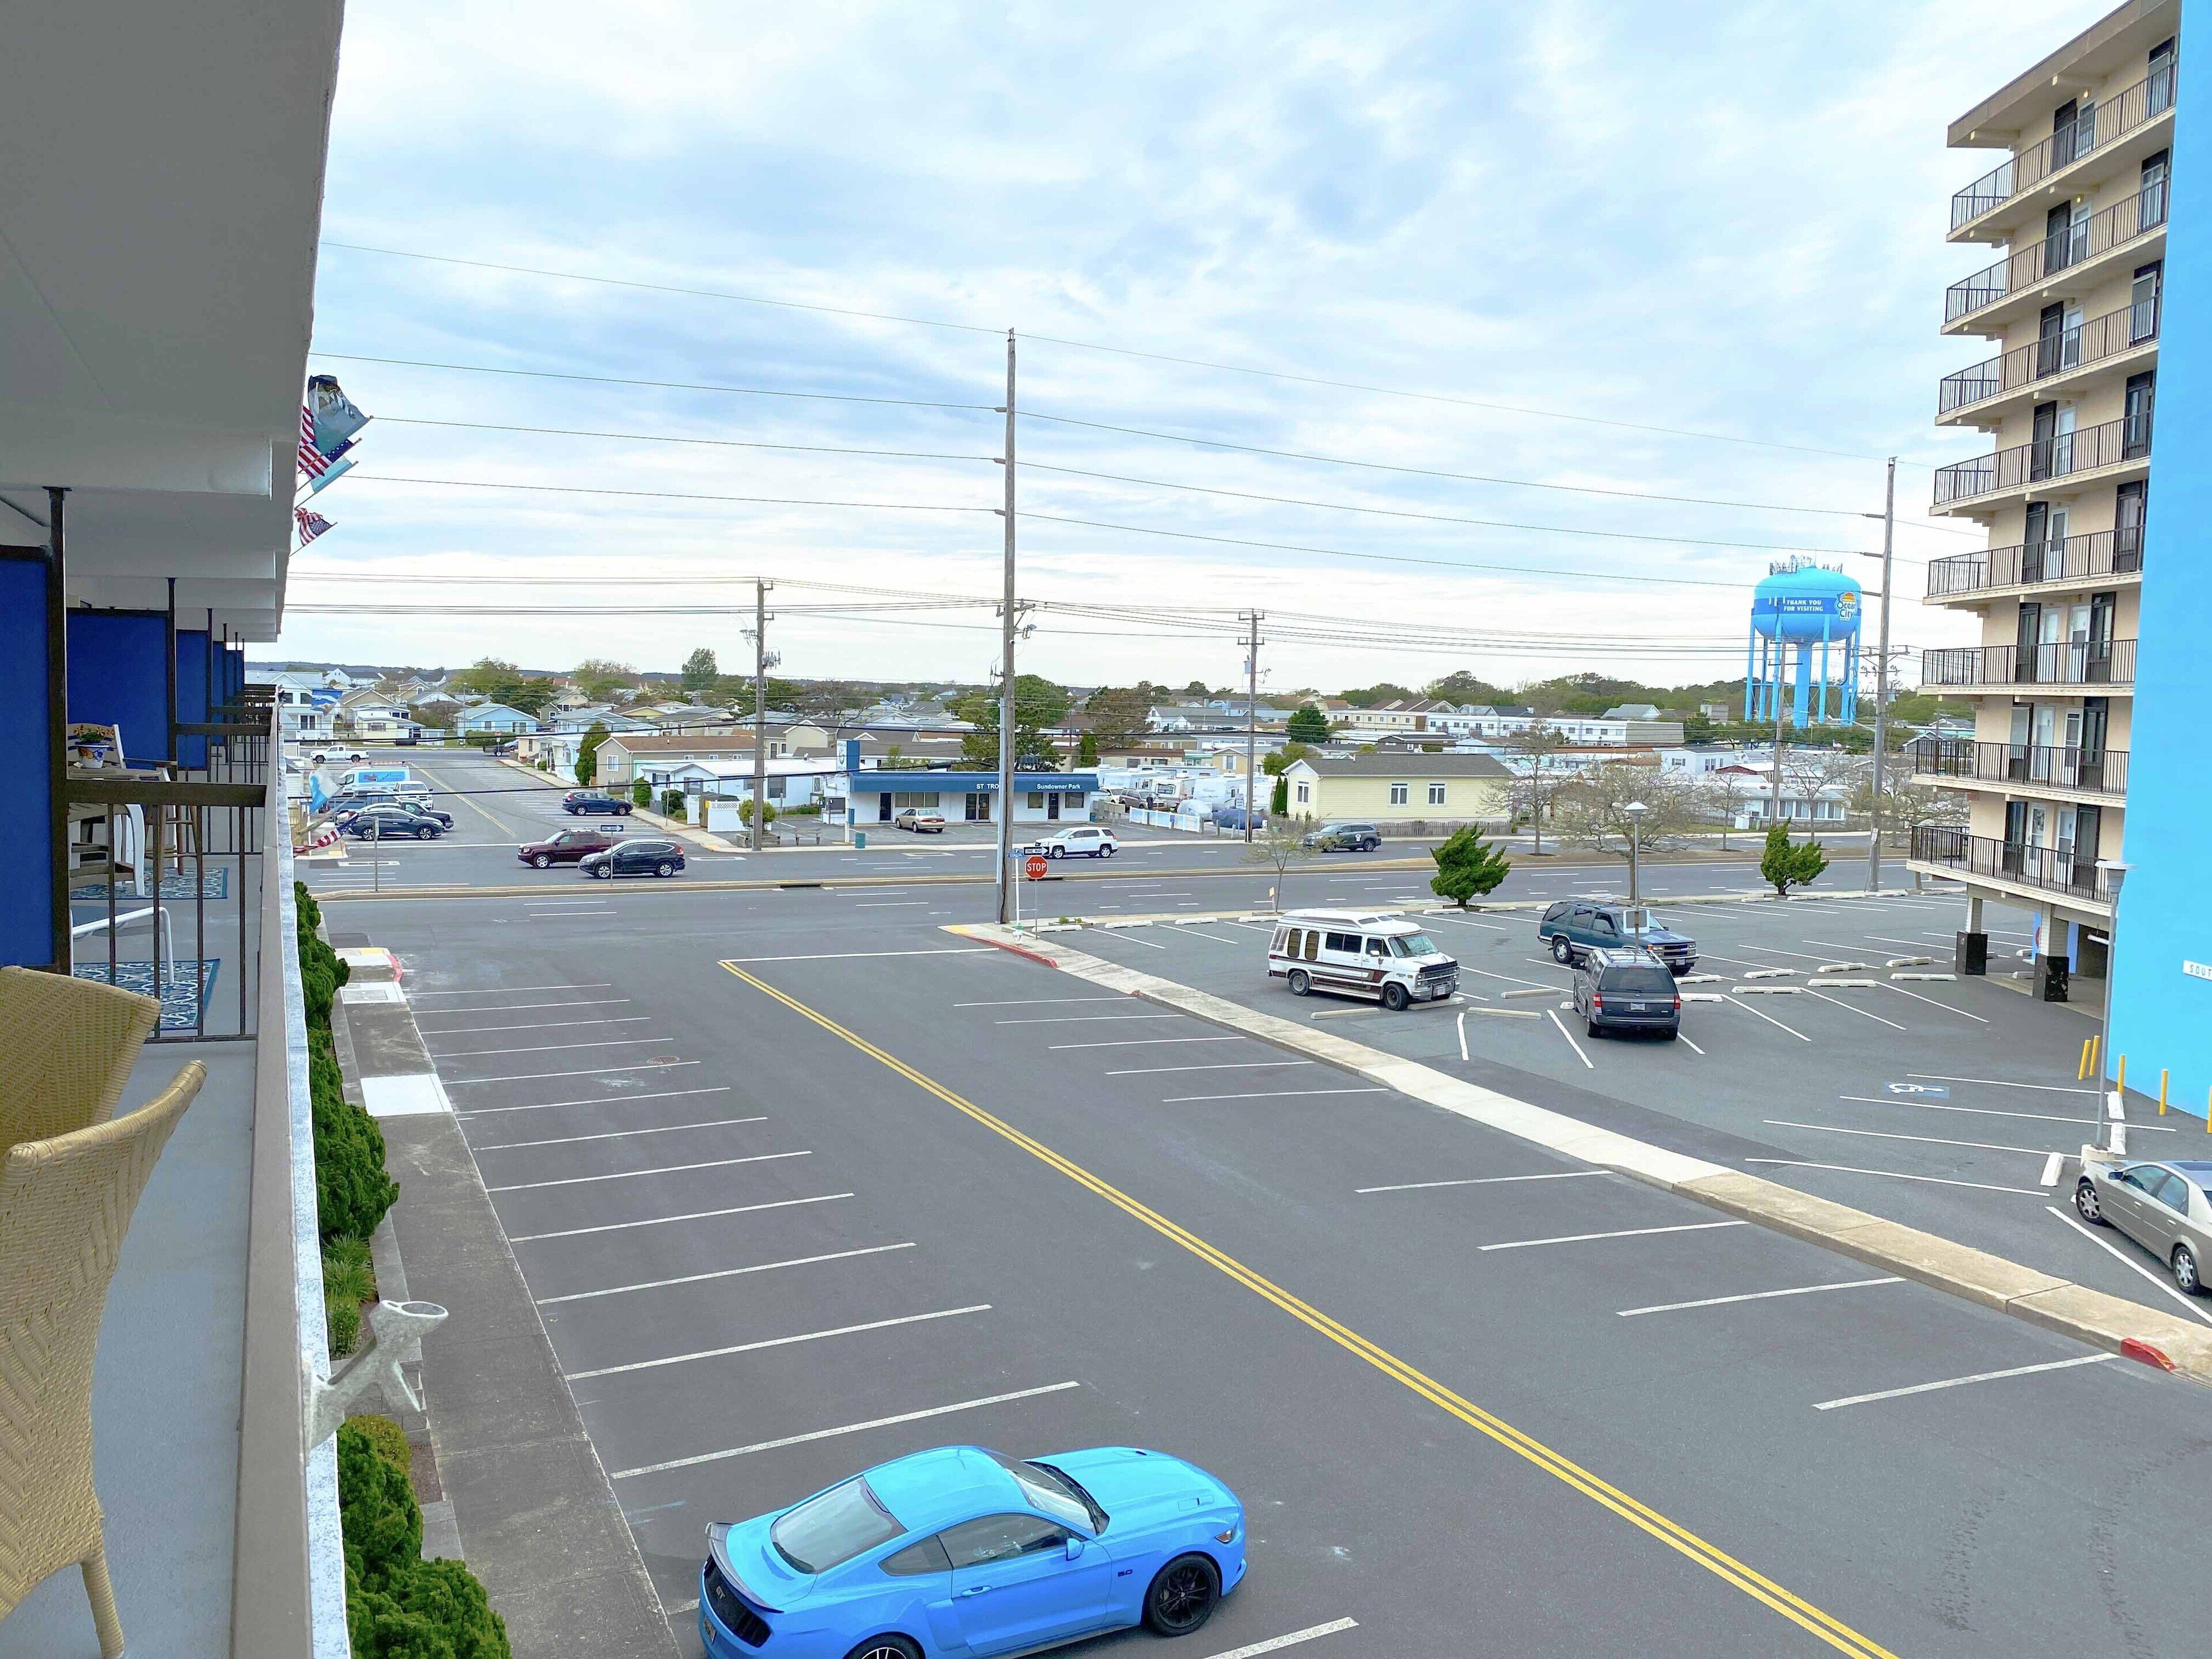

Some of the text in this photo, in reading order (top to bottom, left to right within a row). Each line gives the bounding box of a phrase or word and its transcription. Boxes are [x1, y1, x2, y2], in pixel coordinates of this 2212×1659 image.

[1840, 609, 1854, 619] City
[1027, 862, 1047, 872] STOP
[2190, 964, 2212, 978] SOUT
[716, 1585, 725, 1599] GT
